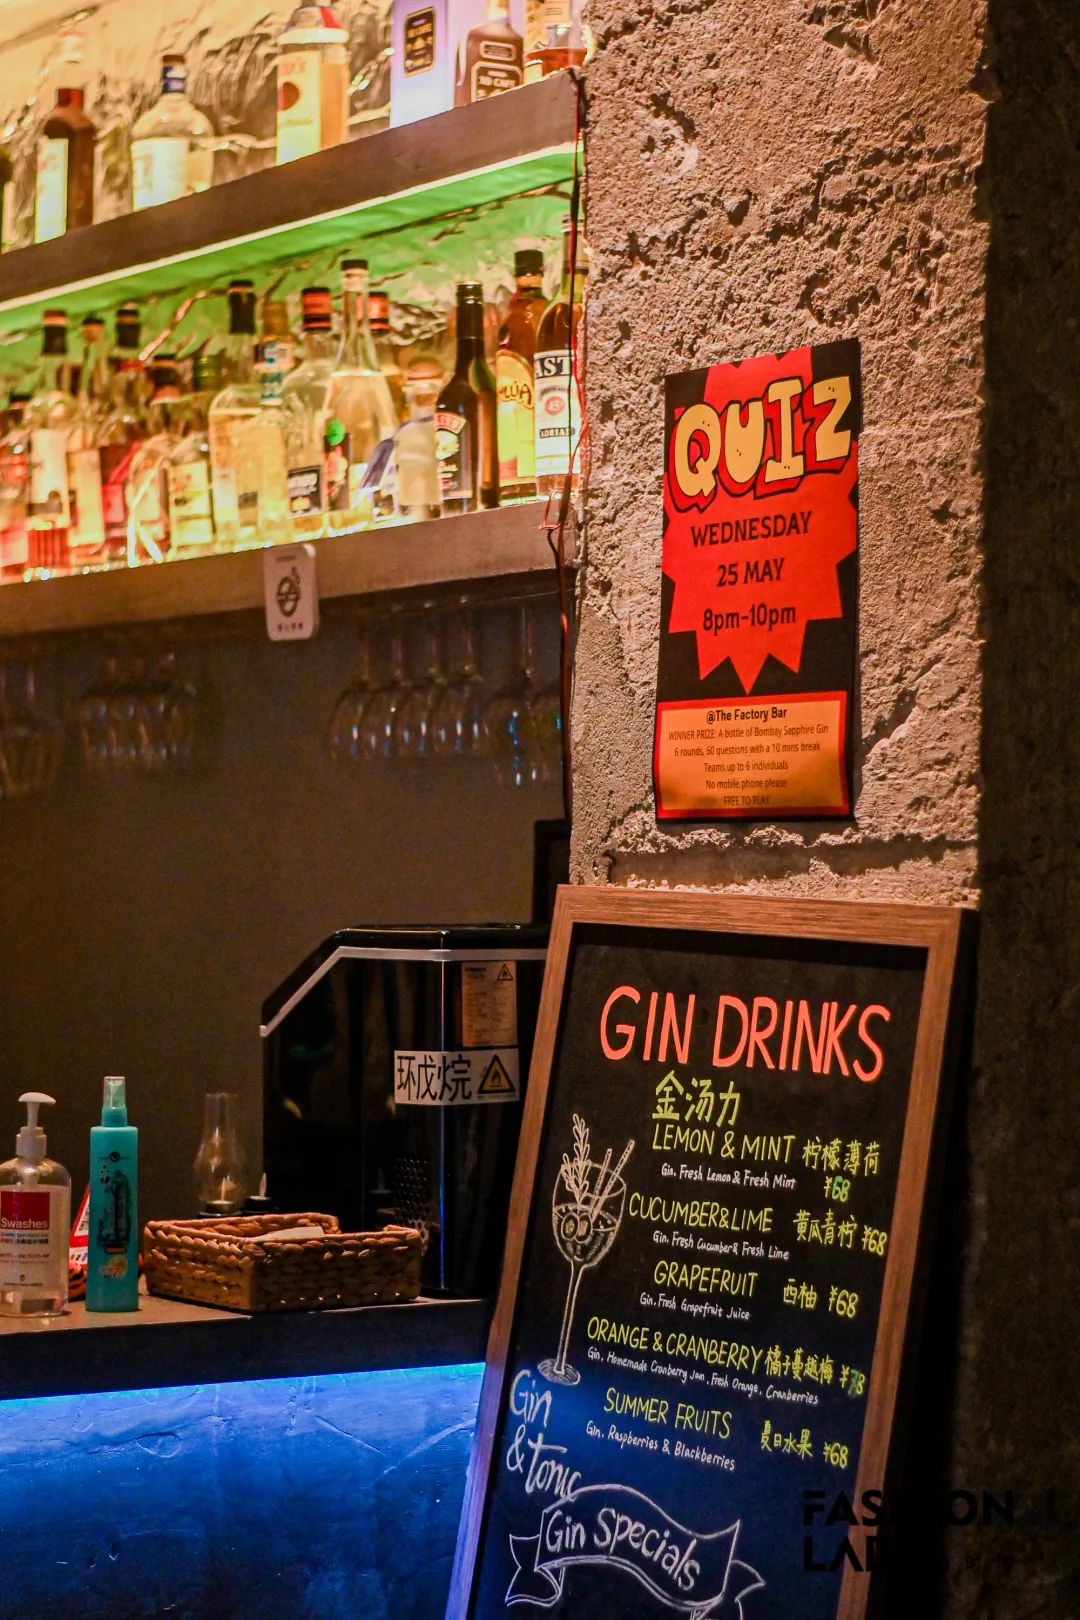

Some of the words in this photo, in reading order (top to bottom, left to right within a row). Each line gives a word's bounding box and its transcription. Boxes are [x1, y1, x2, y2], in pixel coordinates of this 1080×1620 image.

[669, 375, 852, 507] QUIZ
[691, 511, 812, 547] WEDNESDAY
[717, 563, 738, 587] 25
[743, 558, 784, 584] MAY
[703, 603, 796, 636] 8pm-10pm
[669, 731, 695, 741] WINNER
[725, 728, 744, 738] bottle
[746, 726, 753, 737] of
[755, 726, 781, 738] Bombay
[783, 724, 814, 737] Sapphire
[816, 723, 829, 734] Gin
[707, 710, 732, 724] @The
[734, 707, 769, 722] Factory
[771, 706, 788, 718] Bar
[674, 747, 679, 757] 6
[706, 745, 715, 756] 60
[716, 744, 748, 756] questions
[750, 743, 765, 754] with
[766, 744, 770, 753] a
[772, 742, 781, 753] 10
[782, 741, 799, 752] mins
[800, 740, 821, 752] break
[704, 762, 726, 773] Teams
[726, 762, 736, 774] up
[737, 762, 745, 771] to
[745, 761, 750, 771] 6
[751, 759, 789, 771] individuals
[705, 780, 716, 790] No
[716, 779, 740, 789] mobile
[741, 779, 764, 790] phone
[764, 778, 788, 789] please
[723, 795, 740, 806] FREE
[741, 795, 752, 806] TO
[600, 985, 696, 1064] GIN
[712, 994, 891, 1083] DRINKS
[652, 1070, 741, 1128] 金汤力
[652, 1123, 715, 1155] LEMON
[720, 1130, 735, 1159] &
[740, 1134, 796, 1163] MINT
[679, 1164, 703, 1181] Fresh
[743, 1169, 769, 1188] Fresh
[772, 1173, 797, 1190] Mint
[1, 1217, 49, 1229] Swashes
[671, 1231, 694, 1249] Fresh
[741, 1241, 765, 1257] Fresh
[768, 1245, 790, 1261] Lime
[654, 1260, 758, 1297] GRAPEFRUIT
[783, 1278, 818, 1309] 西柚
[828, 1284, 859, 1318] ¥68
[658, 1293, 677, 1310] Fresh
[681, 1298, 724, 1318] Grapefruit
[726, 1306, 750, 1320] Juice
[587, 1316, 650, 1350] ORANGE
[652, 1331, 663, 1353] &
[666, 1333, 763, 1375] CRANBERRY
[607, 1350, 648, 1373] Homemade
[650, 1360, 688, 1384] Cranberry
[711, 1372, 729, 1388] Fresh
[765, 1384, 819, 1405] Cranberries
[510, 1369, 552, 1428] Gin
[603, 1387, 669, 1425] SUMMER
[674, 1402, 733, 1440] FRUITS
[506, 1424, 526, 1473] &
[608, 1424, 659, 1450] Raspberries
[662, 1438, 671, 1455] &
[674, 1440, 737, 1472] Blackberries
[546, 1509, 586, 1552] Gin
[594, 1507, 700, 1591] Specials
